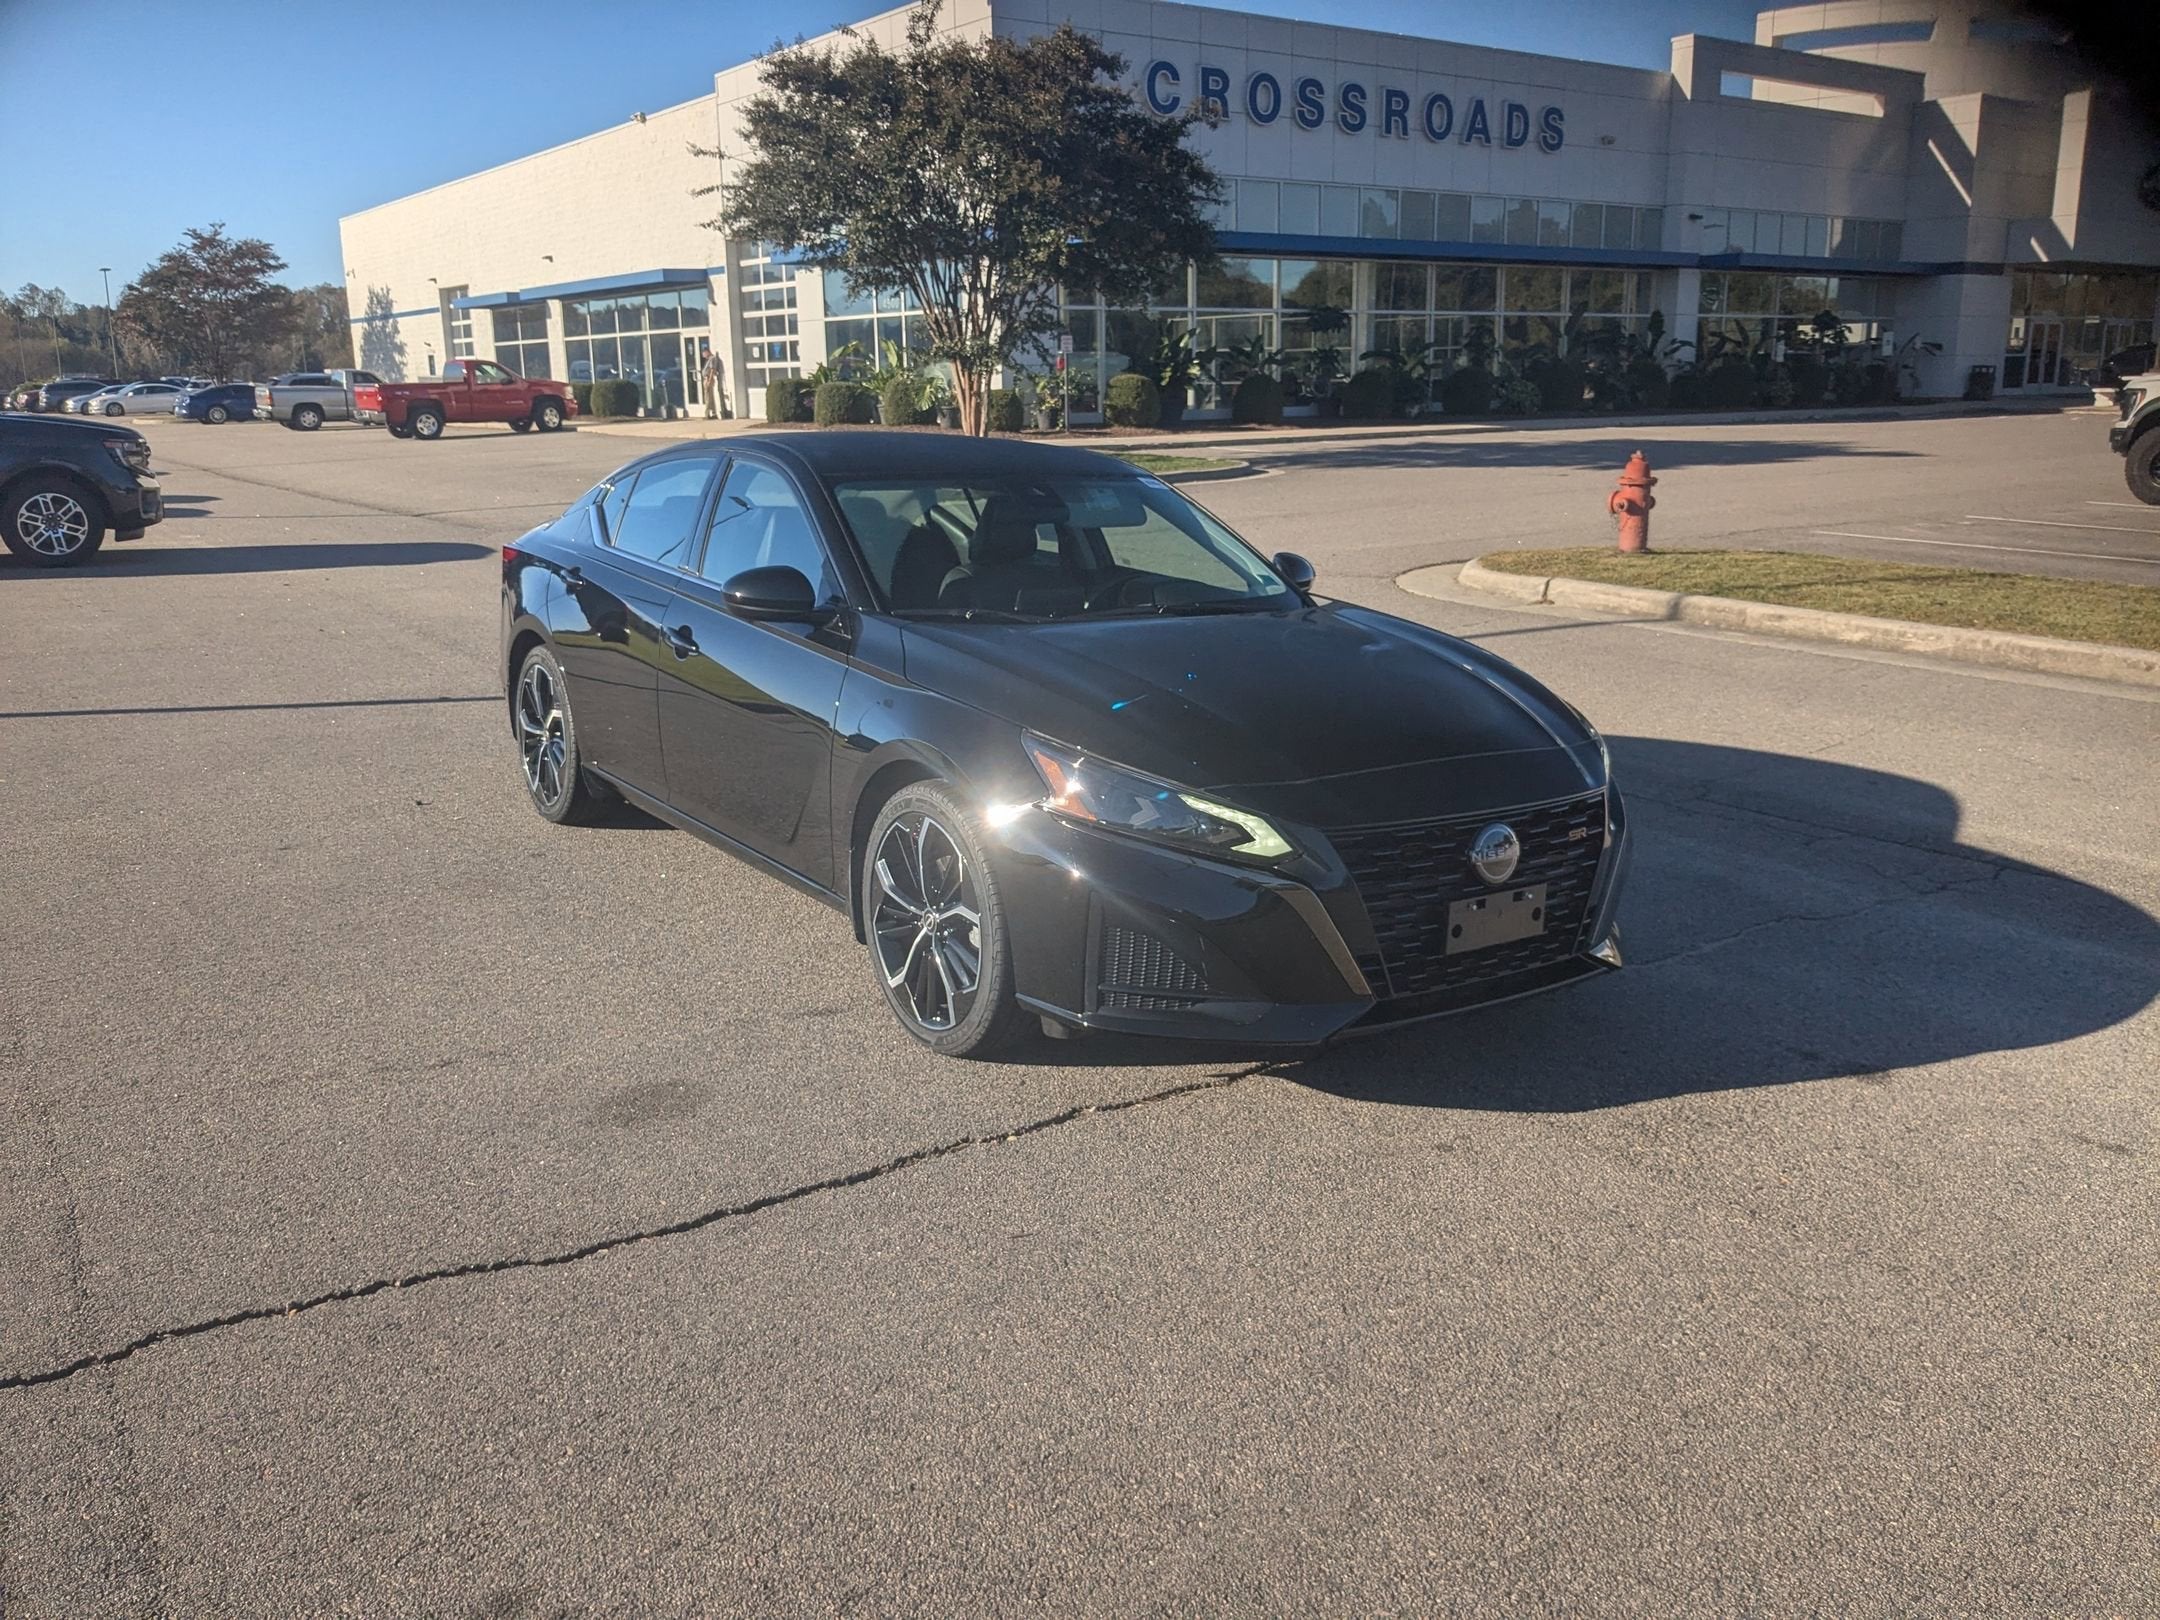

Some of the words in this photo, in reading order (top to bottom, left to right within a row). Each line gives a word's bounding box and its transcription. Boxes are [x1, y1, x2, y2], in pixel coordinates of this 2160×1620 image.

[1146, 60, 1564, 153] CROSSROADS
[1568, 826, 1587, 841] SR
[1472, 846, 1516, 863] NISS
